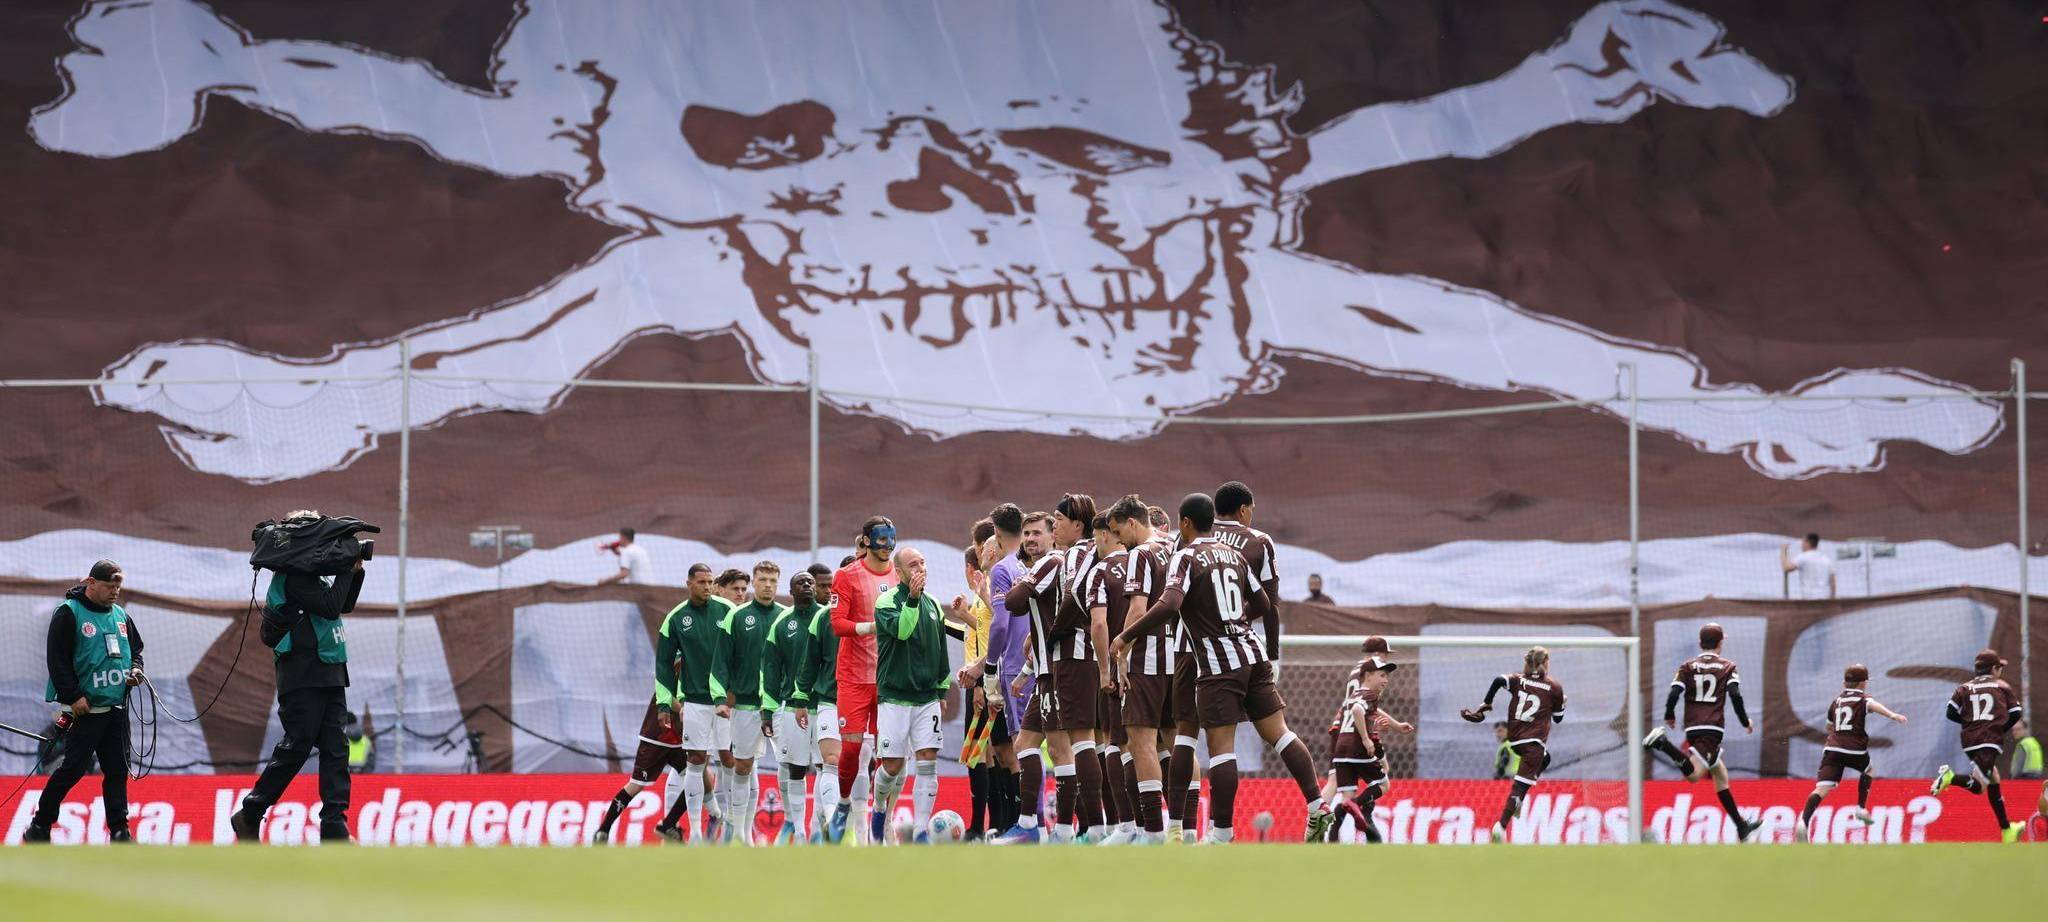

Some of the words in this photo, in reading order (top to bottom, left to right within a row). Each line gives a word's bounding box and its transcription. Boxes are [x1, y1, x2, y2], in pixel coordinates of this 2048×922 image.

[1214, 531, 1248, 550] PAULI
[1110, 562, 1127, 579] ST
[1196, 550, 1214, 568] ST.
[1211, 549, 1239, 566] PAULI
[1211, 567, 1243, 621] 16
[1693, 673, 1717, 703] 12
[1515, 690, 1541, 722] 12
[1835, 706, 1853, 731] 12
[1970, 693, 1995, 721] 12
[1340, 709, 1355, 734] 12
[1508, 793, 1631, 845] Was
